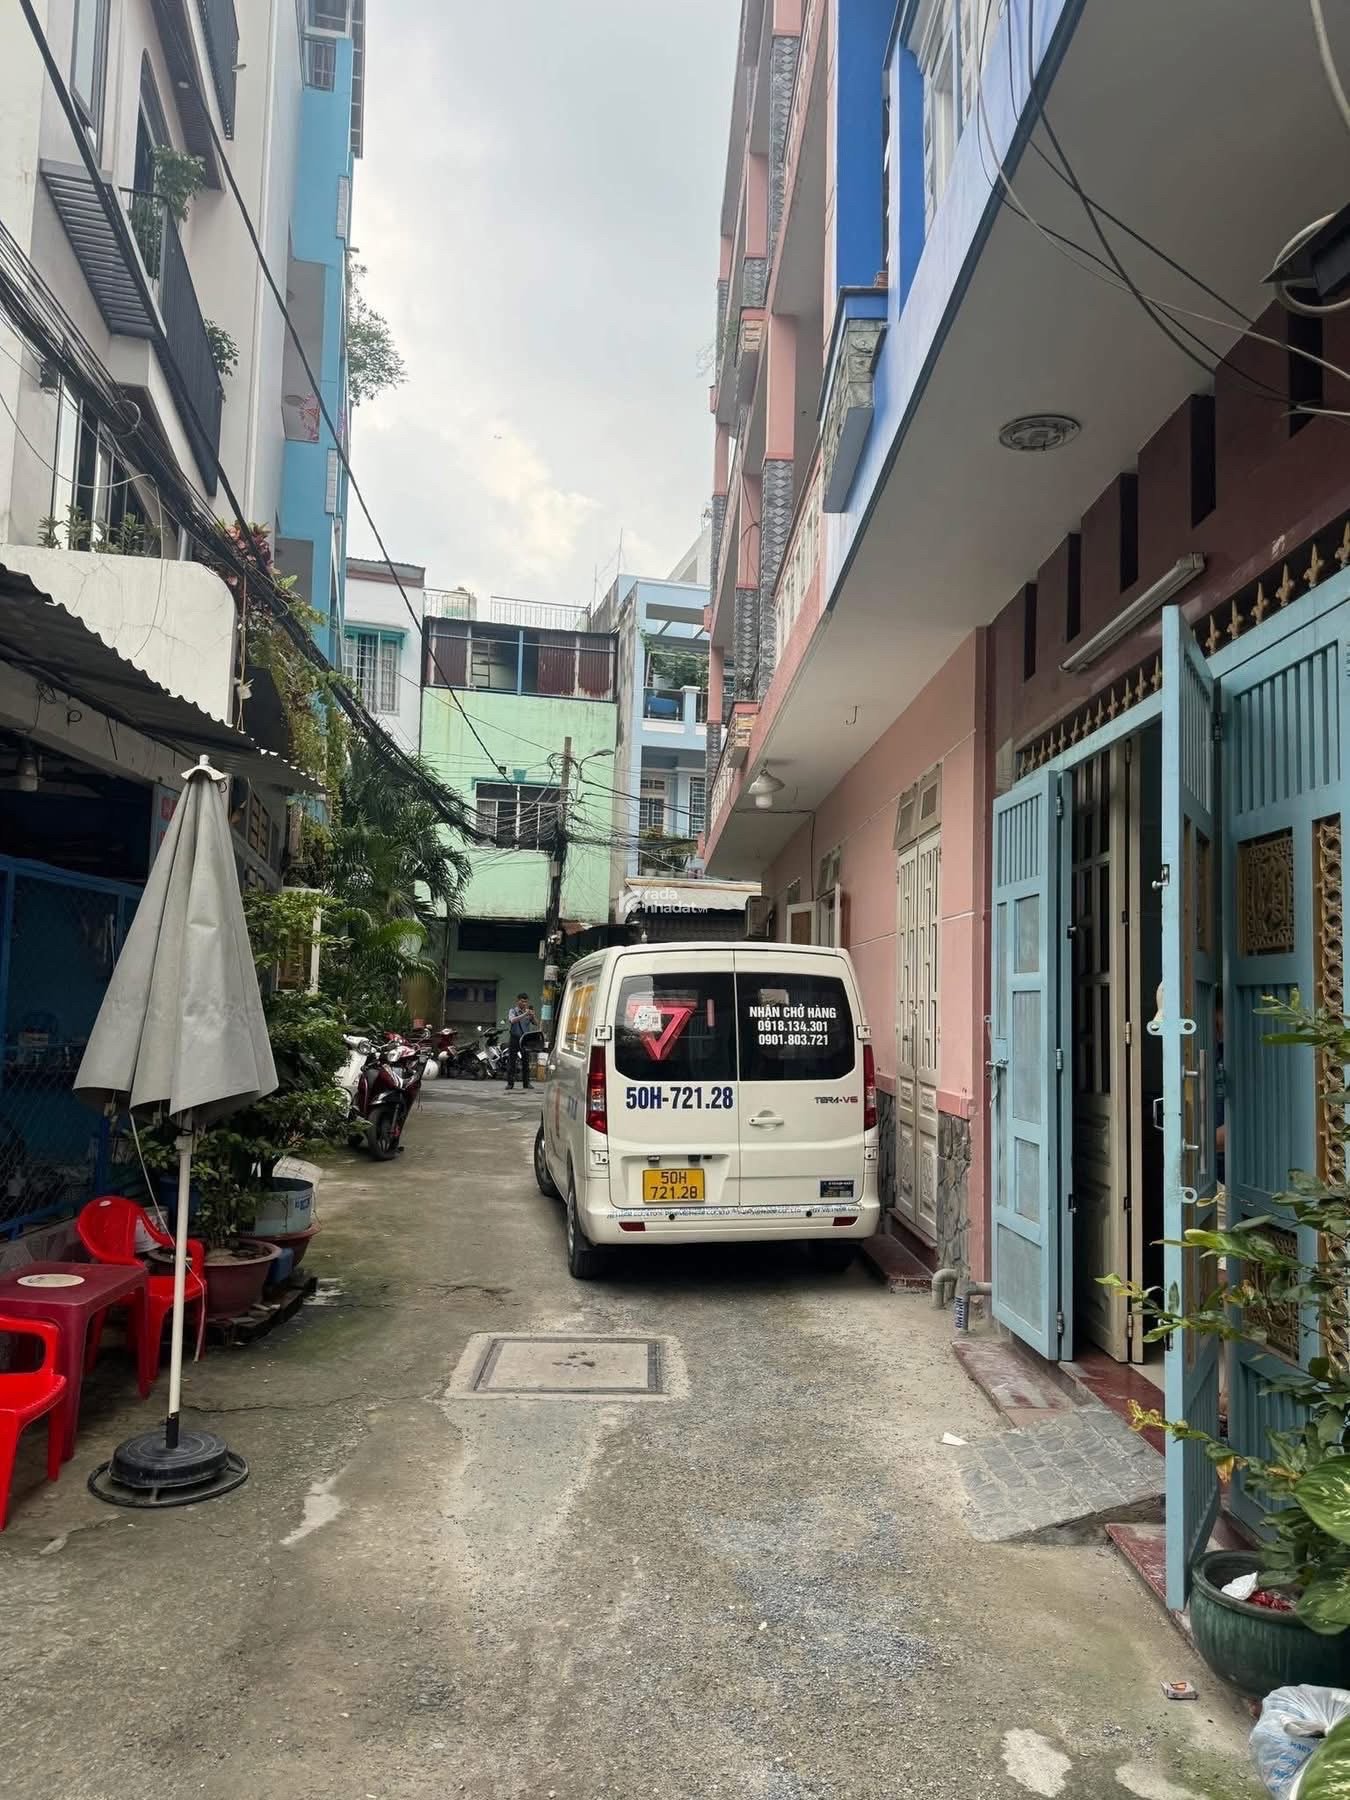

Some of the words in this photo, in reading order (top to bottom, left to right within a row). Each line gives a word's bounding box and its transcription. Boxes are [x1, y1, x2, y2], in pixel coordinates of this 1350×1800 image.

[749, 1004, 780, 1020] NHẬN
[783, 1003, 805, 1018] CHỞ
[807, 1004, 837, 1018] HÀNG
[758, 1020, 828, 1032] 0918.134.301
[759, 1034, 828, 1046] 0901.803.721
[626, 1086, 733, 1109] 50H-721.28
[661, 1171, 687, 1184] 50H
[650, 1186, 698, 1199] 721.28
